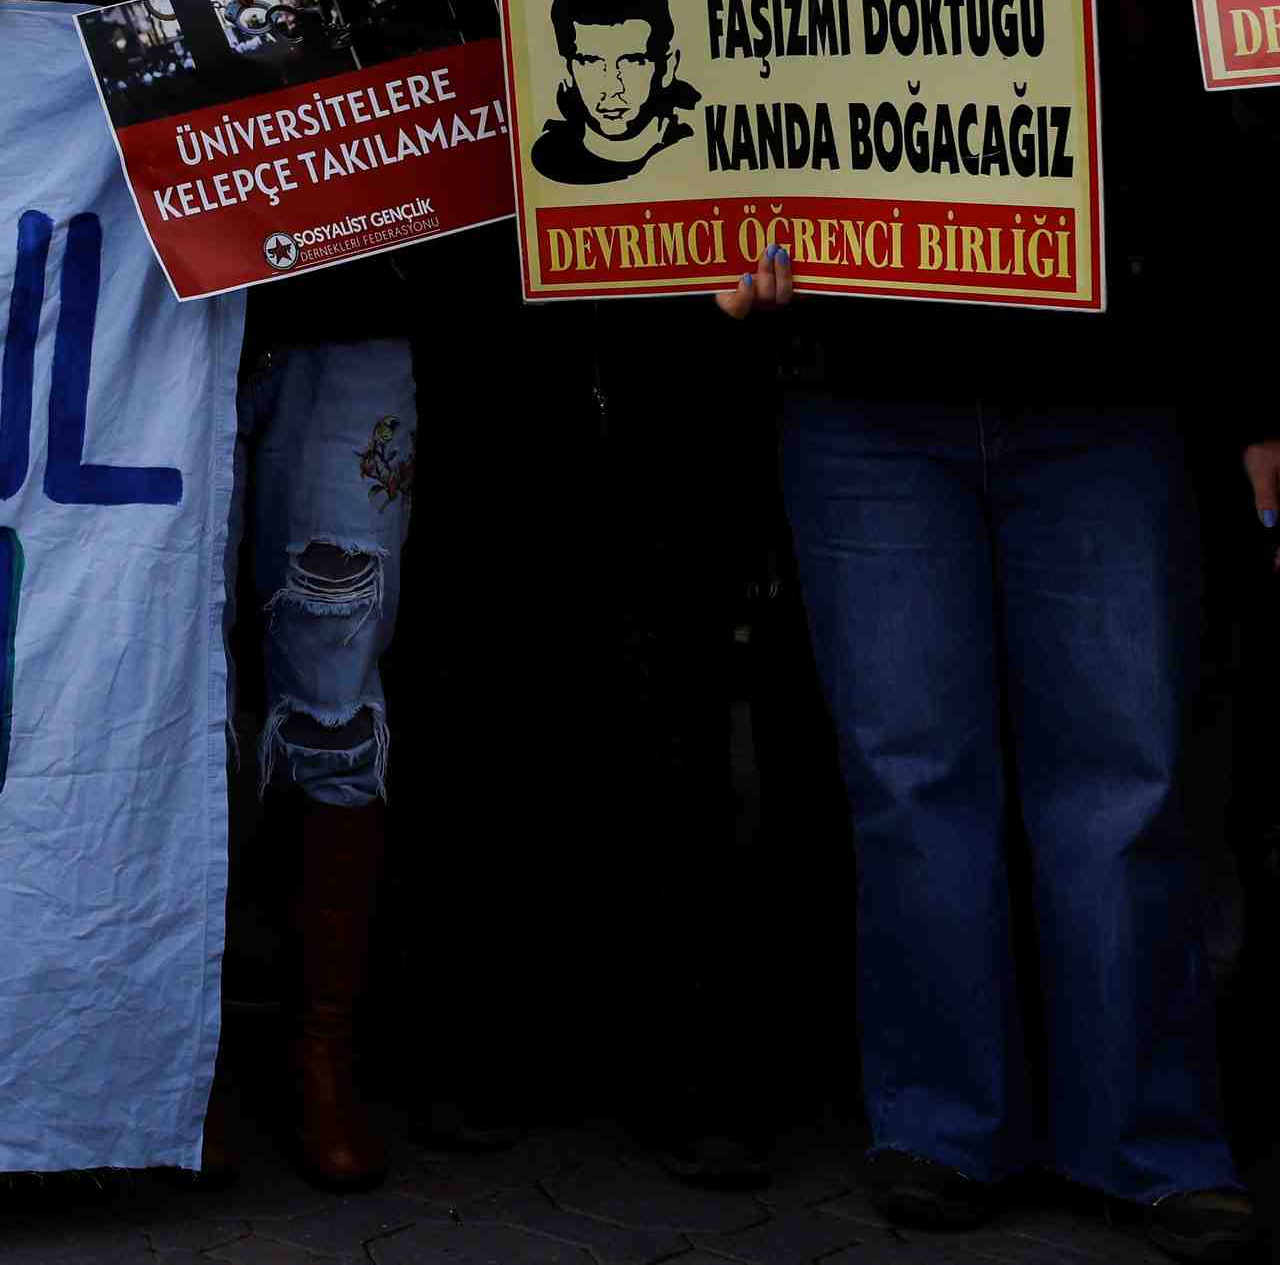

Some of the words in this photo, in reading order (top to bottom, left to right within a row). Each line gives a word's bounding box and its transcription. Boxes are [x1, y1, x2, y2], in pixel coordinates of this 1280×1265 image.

[152, 162, 299, 221] KELEPÇE
[297, 100, 509, 184] TAKILAMAZ!
[175, 68, 457, 166] ÜNİVERSİTELERE
[705, 102, 840, 173] KANDA
[849, 79, 1075, 179] BOĞACAĞIZ
[293, 215, 370, 248] SOSYALİST
[371, 197, 435, 232] GENÇLİK
[299, 235, 362, 263] DERNEKLERİ
[362, 215, 441, 247] FEDERASYONU
[547, 205, 726, 273] DEVRİMCİ
[738, 203, 905, 271] ÖĞRENCİ
[918, 209, 1073, 280] BİRLİĞİ
